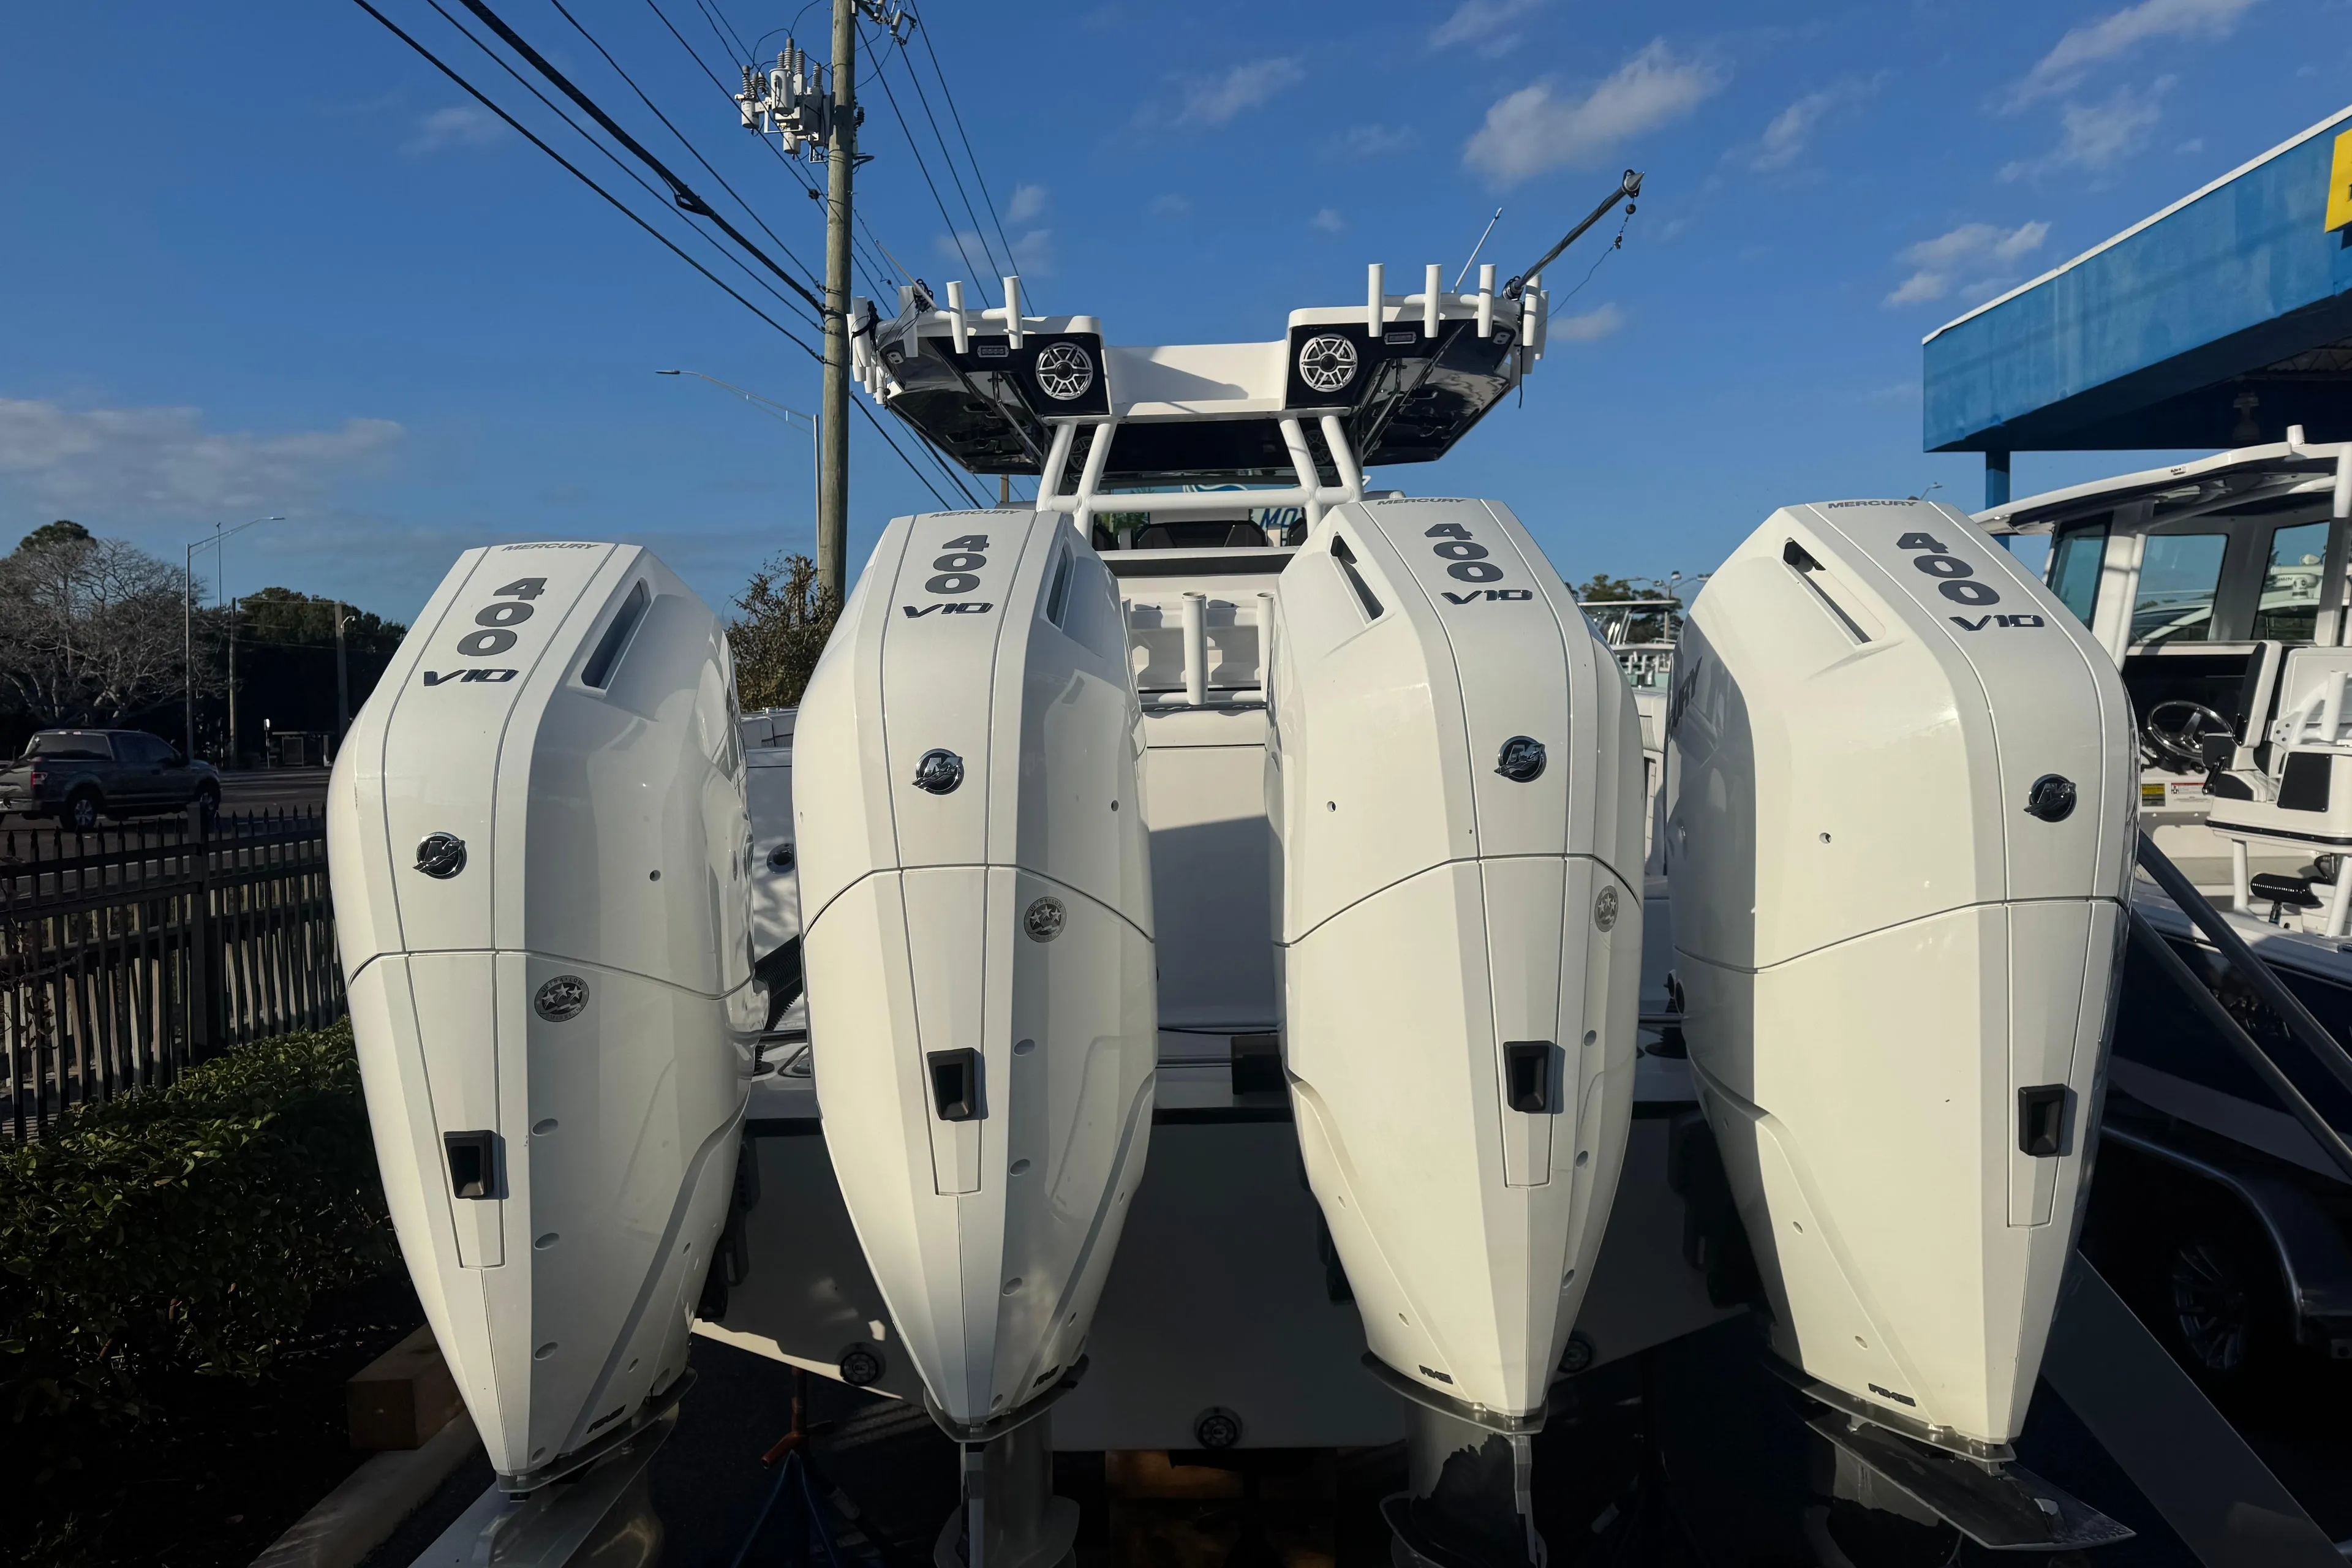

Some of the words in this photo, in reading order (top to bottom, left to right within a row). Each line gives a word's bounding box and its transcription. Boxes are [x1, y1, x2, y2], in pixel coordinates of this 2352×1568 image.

[1828, 500, 1918, 509] MERCURY
[929, 510, 1022, 518] MERCURY
[502, 543, 599, 552] MERCURY
[1424, 523, 1504, 582] 400
[925, 534, 990, 594] 400
[1896, 532, 2000, 606] 400
[1441, 589, 1533, 605] V10
[457, 577, 548, 657] 400
[903, 602, 994, 618] V10
[1949, 614, 2045, 631] V10
[423, 668, 519, 687] V10
